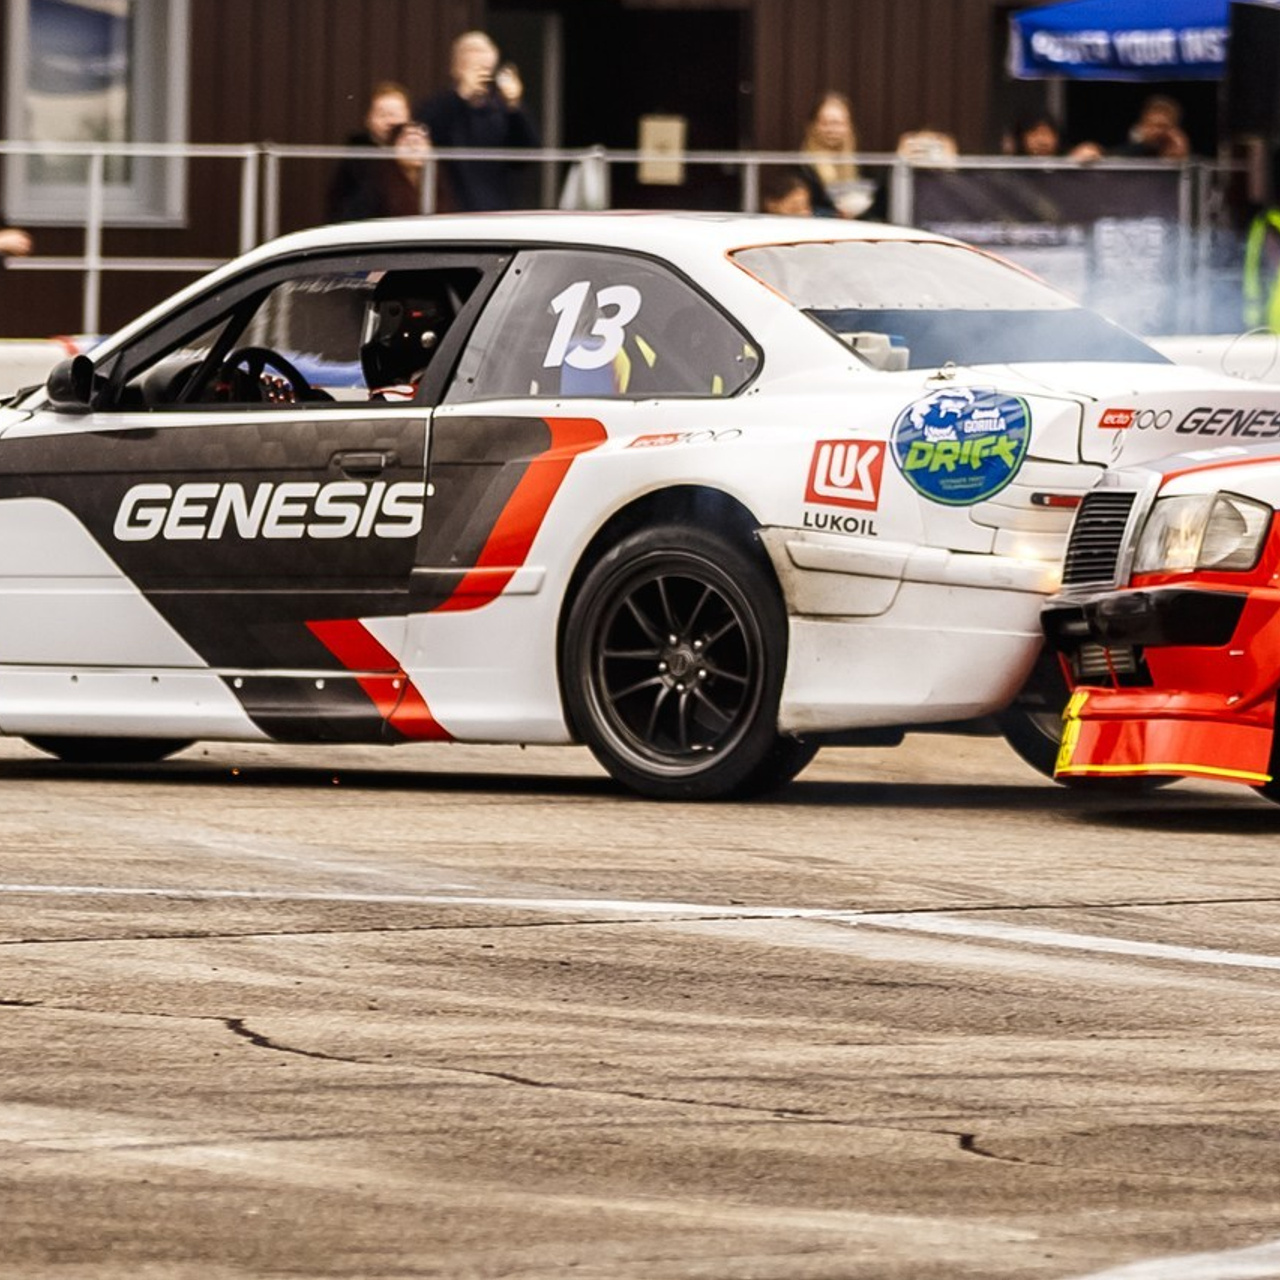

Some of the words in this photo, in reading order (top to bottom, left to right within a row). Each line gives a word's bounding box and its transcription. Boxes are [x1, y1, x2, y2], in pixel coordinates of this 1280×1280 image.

[543, 280, 642, 370] 13
[964, 417, 1006, 433] GORILLA
[904, 434, 1018, 473] DRIFT
[113, 481, 435, 542] GENESIS
[803, 511, 878, 536] LUKOIL
